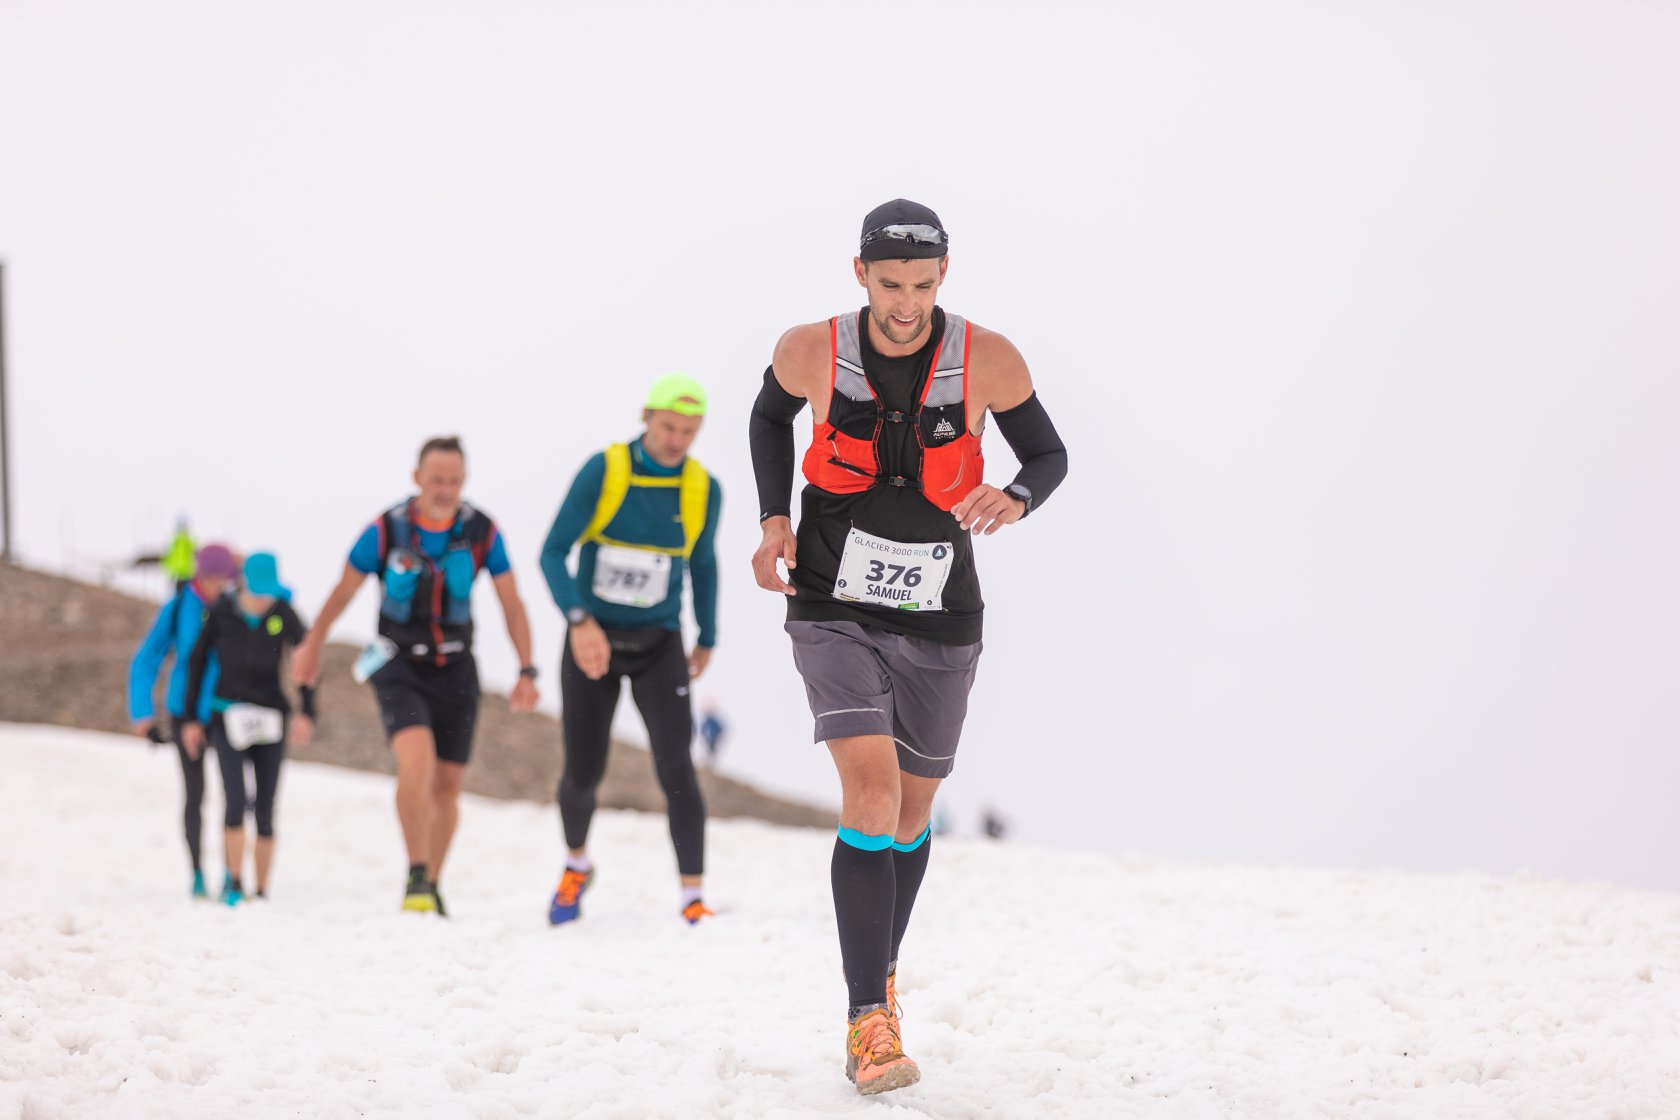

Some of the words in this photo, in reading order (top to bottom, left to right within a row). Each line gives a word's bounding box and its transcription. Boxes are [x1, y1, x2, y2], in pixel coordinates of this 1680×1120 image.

[854, 536, 890, 552] GLACIER
[891, 547, 912, 556] 3000
[913, 549, 930, 557] RUN
[865, 559, 922, 588] 376
[865, 583, 912, 601] SAMUEL
